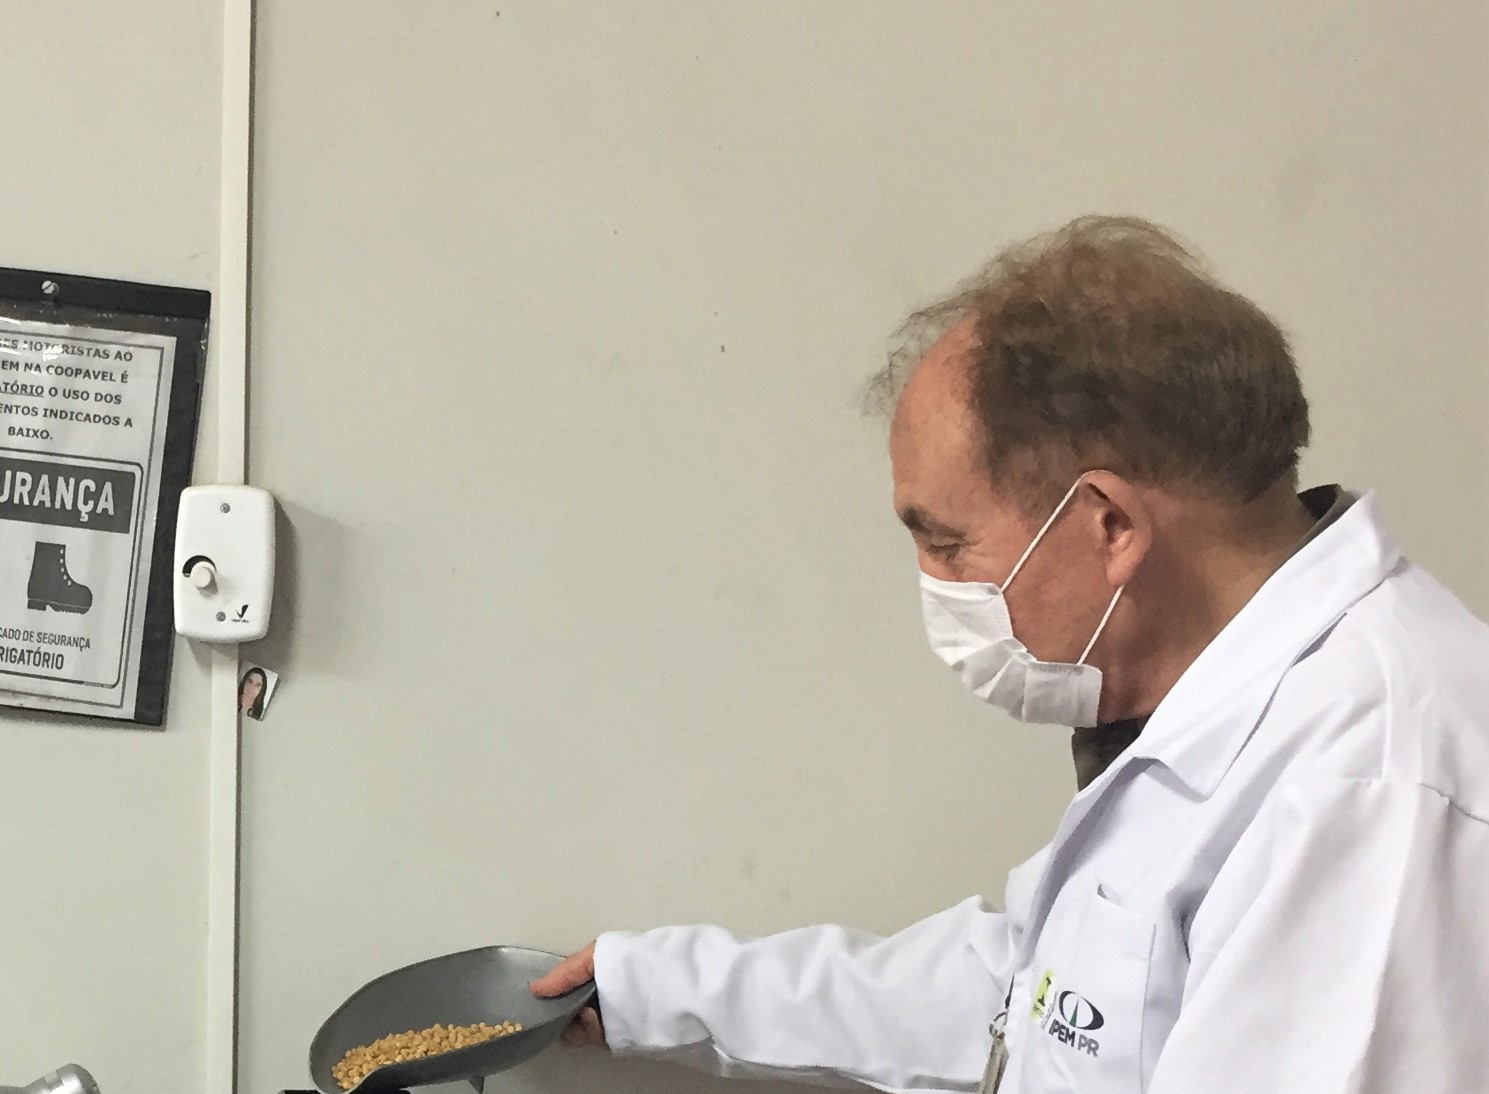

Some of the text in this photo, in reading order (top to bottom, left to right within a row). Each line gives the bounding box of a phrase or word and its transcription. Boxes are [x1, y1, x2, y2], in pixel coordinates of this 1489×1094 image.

[114, 351, 133, 362] AO
[24, 362, 42, 373] NA
[46, 364, 116, 382] COOPAVEL
[121, 370, 129, 383] É
[48, 387, 59, 397] O
[62, 388, 90, 401] USO
[94, 392, 122, 405] DOS
[42, 407, 120, 426] INDICADOS
[124, 418, 133, 428] A
[8, 426, 53, 440] BAIXO.
[23, 630, 34, 642] DE
[36, 631, 91, 651] SEGURANÇA
[1048, 1018, 1100, 1057] IPEM PR
